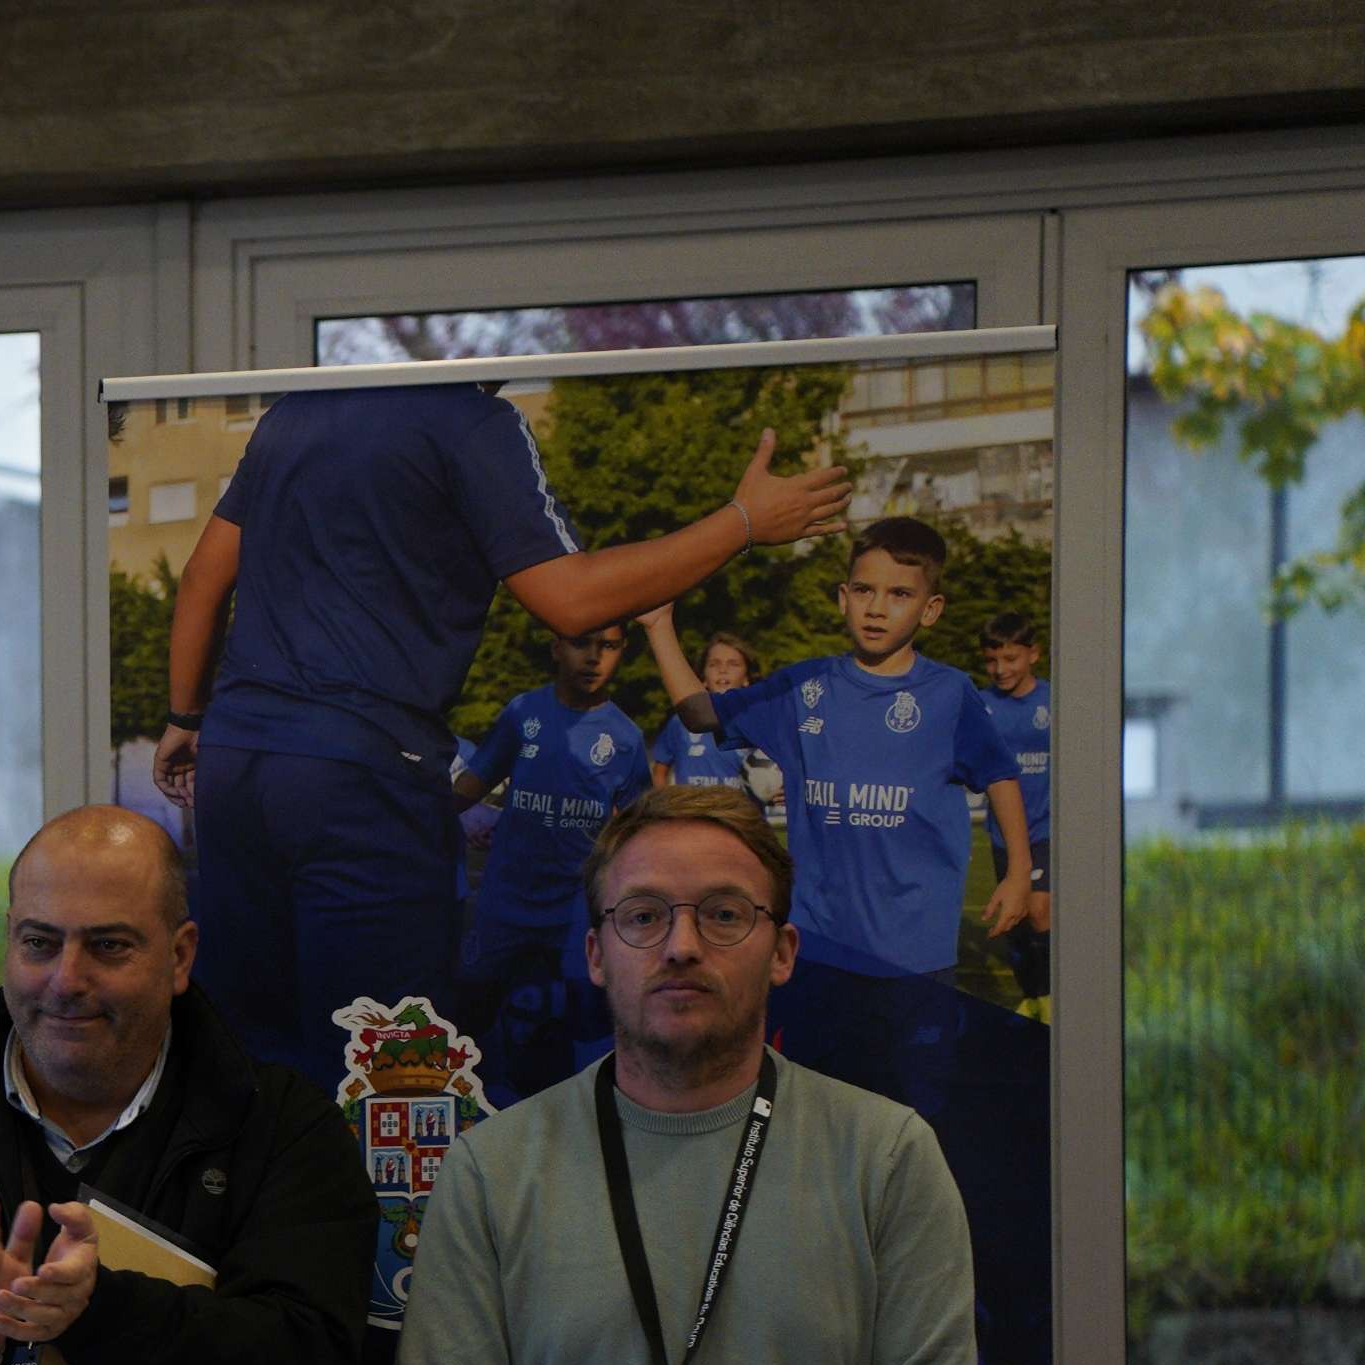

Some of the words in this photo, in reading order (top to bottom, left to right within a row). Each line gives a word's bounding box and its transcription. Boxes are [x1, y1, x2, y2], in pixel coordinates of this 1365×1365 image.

[512, 789, 555, 814] RETAIL
[561, 797, 605, 818] MIND
[806, 779, 840, 807] TAIL
[848, 783, 910, 812] MIND
[848, 812, 905, 828] GROUP
[375, 1030, 411, 1040] INVICTA
[744, 1119, 764, 1158] Instituto
[733, 1157, 755, 1200] Superior
[729, 1199, 742, 1212] de
[717, 1211, 740, 1252] Ciências
